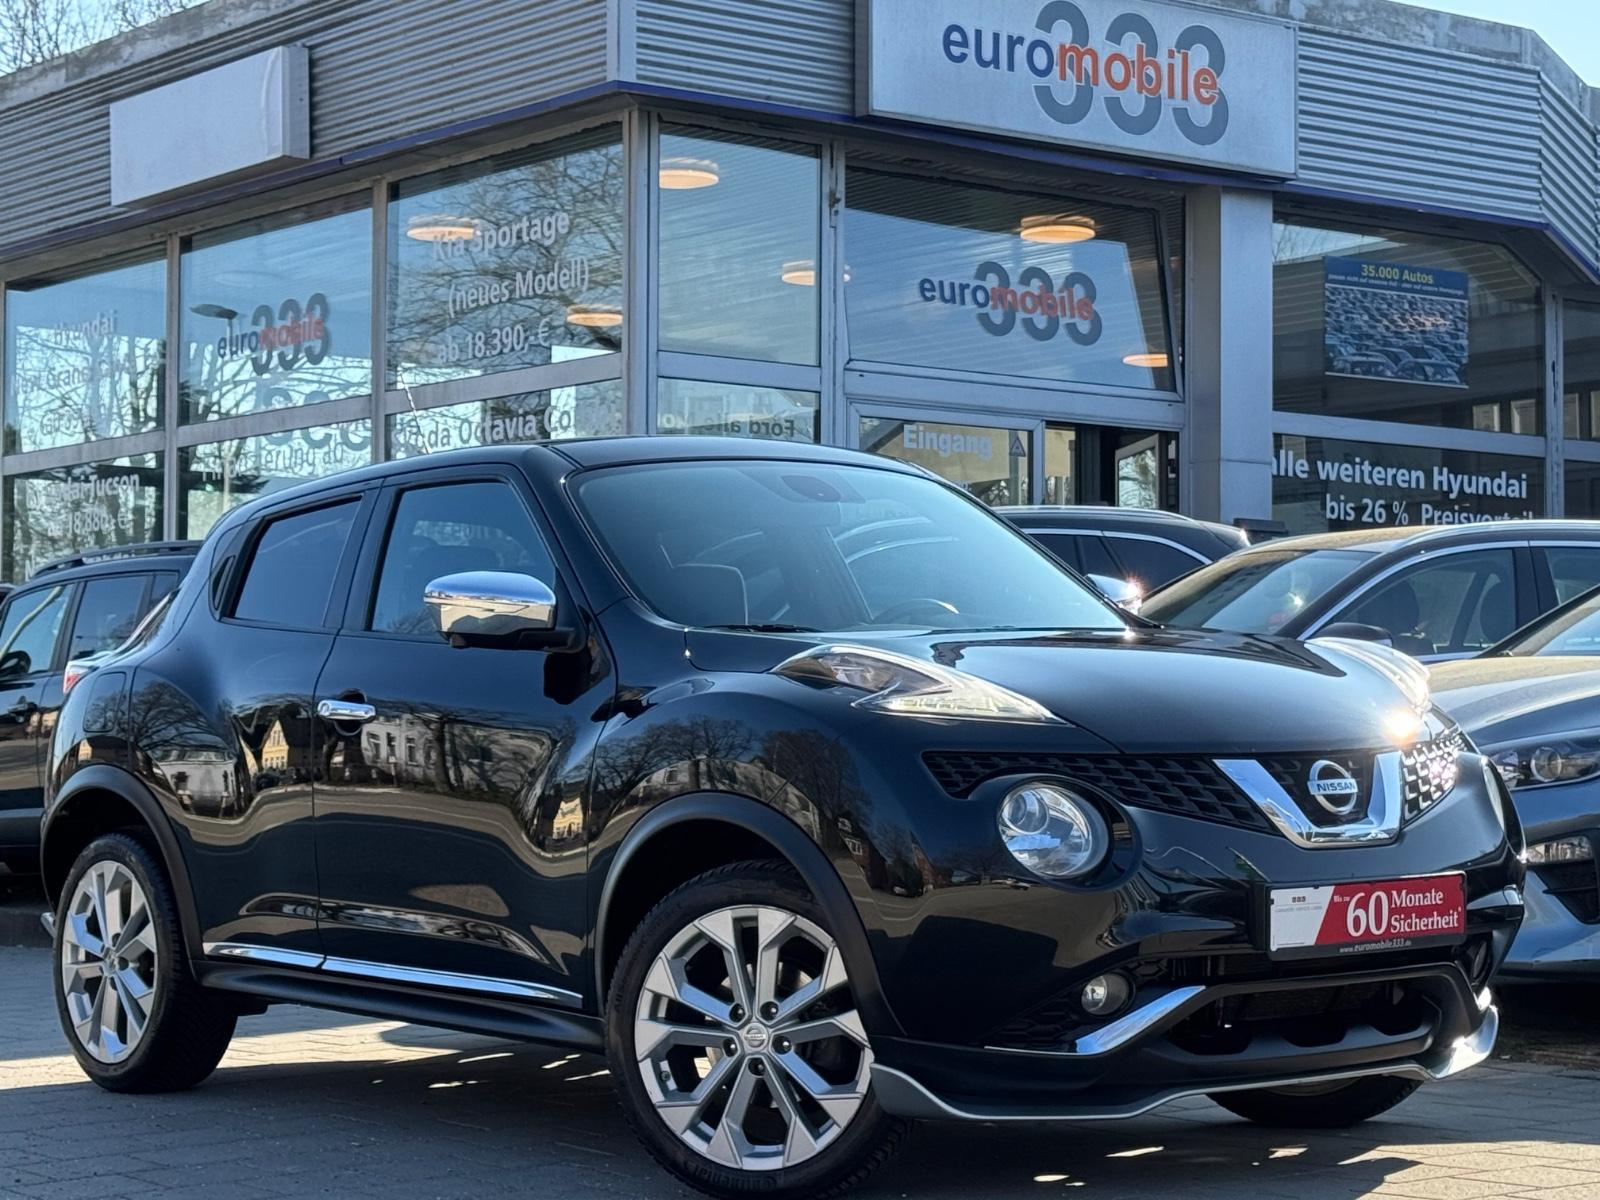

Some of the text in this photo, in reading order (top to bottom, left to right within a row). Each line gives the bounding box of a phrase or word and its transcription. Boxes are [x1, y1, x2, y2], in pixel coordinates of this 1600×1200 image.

[943, 0, 1229, 146] euromobile 333
[468, 212, 570, 258] Sportage
[449, 257, 589, 318] (neues Modell)
[1361, 264, 1400, 279] 35.000
[1402, 270, 1435, 285] Autos
[919, 261, 1102, 346] euromobile 333
[218, 293, 331, 376] euromobile 333
[459, 408, 537, 444] Octavia
[904, 424, 993, 463] Eingang
[1317, 457, 1425, 489] weiteren
[1433, 466, 1528, 499] Hyundai
[1326, 494, 1533, 525] bis 26 % Preisvo
[1316, 781, 1355, 793] NISSAN
[1346, 889, 1443, 937] 60 Monate
